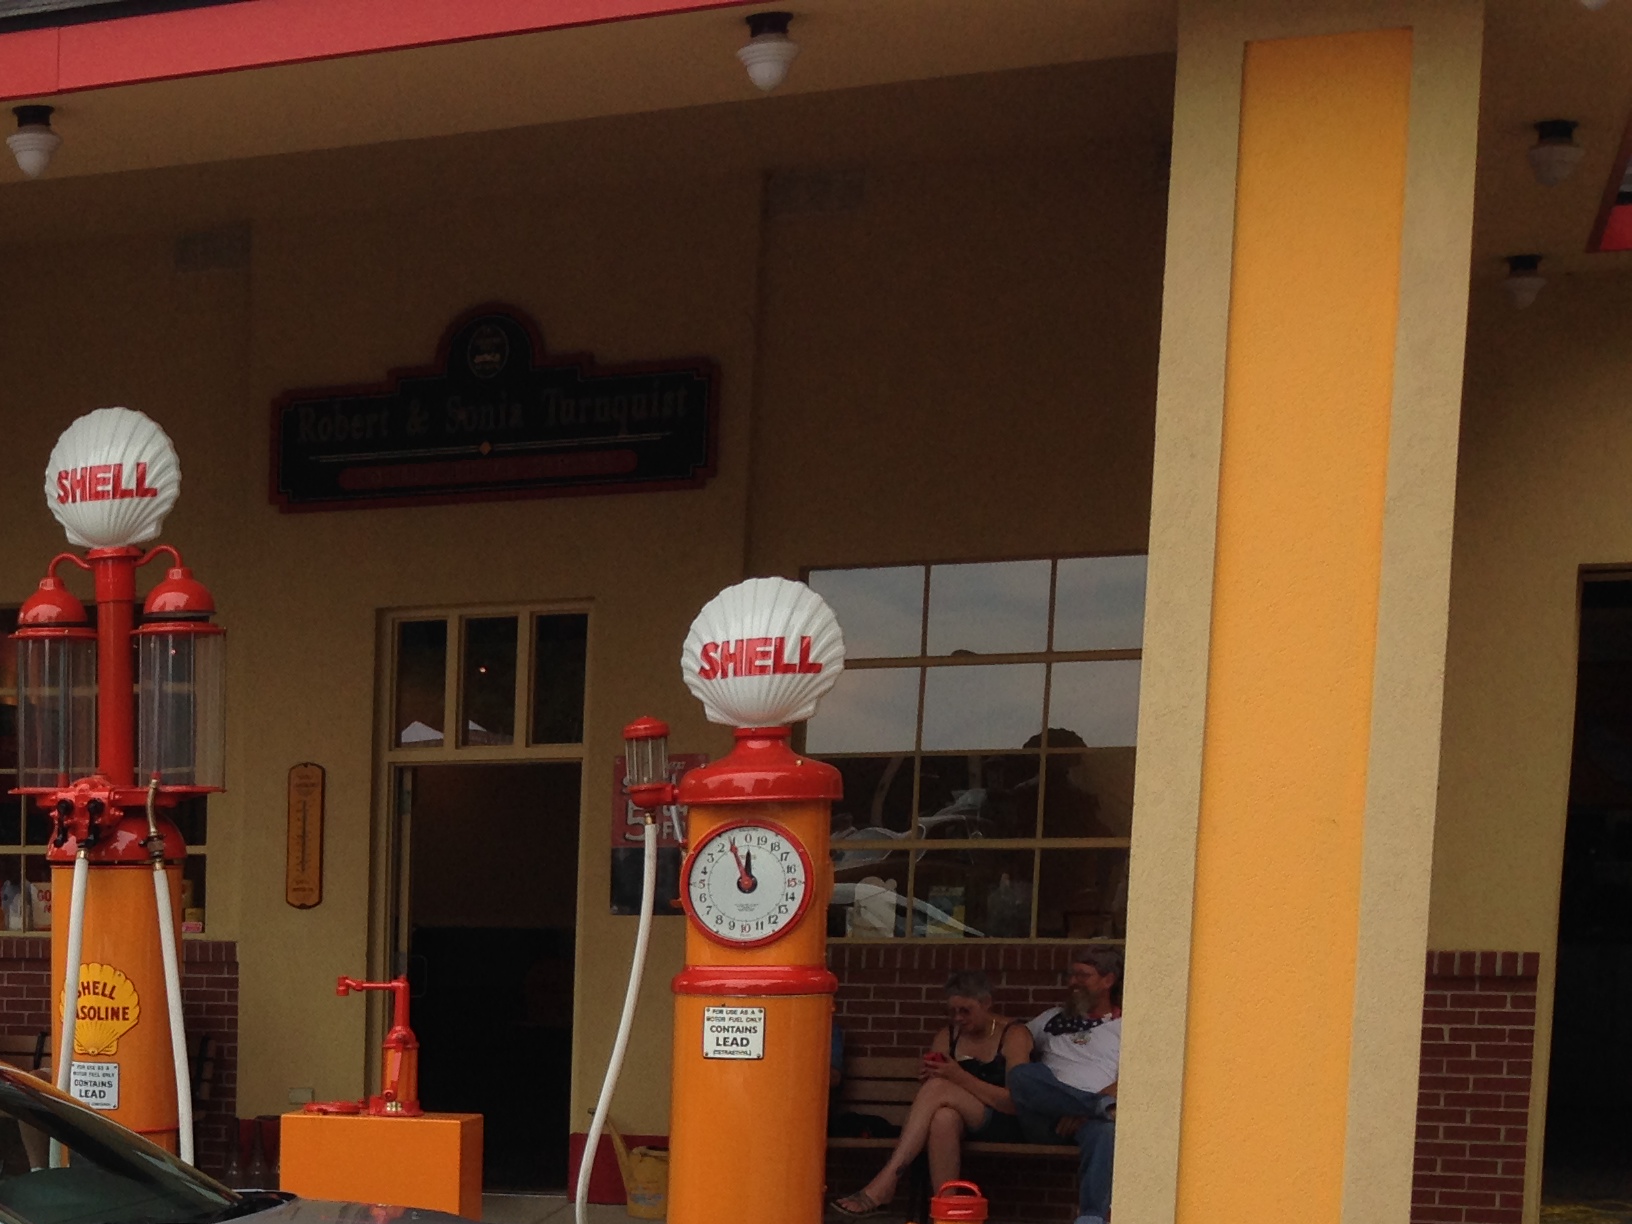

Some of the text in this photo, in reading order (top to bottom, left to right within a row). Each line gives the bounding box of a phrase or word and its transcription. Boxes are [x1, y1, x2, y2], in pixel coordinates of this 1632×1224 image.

[406, 398, 430, 436] &
[57, 462, 158, 505] SHELL
[698, 635, 823, 681] SHELL
[745, 833, 753, 844] 0
[757, 836, 768, 846] 19
[718, 842, 726, 854] 2
[770, 841, 781, 852] 18
[707, 853, 715, 863] 3
[780, 851, 790, 862] 17
[700, 866, 707, 876] 4
[786, 864, 797, 874] 16
[698, 879, 706, 889] 5
[786, 877, 798, 888] 15
[699, 892, 707, 903] 6
[785, 891, 796, 902] 14
[706, 905, 713, 915] 7
[778, 904, 789, 915] 13
[715, 915, 724, 925] 8
[728, 920, 735, 931] 9
[768, 915, 779, 925] 12
[740, 922, 751, 934] 10
[755, 921, 764, 931] 11
[76, 1005, 130, 1021] SOLINE
[709, 1025, 758, 1034] CONTAINS
[715, 1036, 750, 1047] LEAD
[74, 1079, 114, 1088] CONTAINS
[79, 1089, 107, 1099] LEAD
